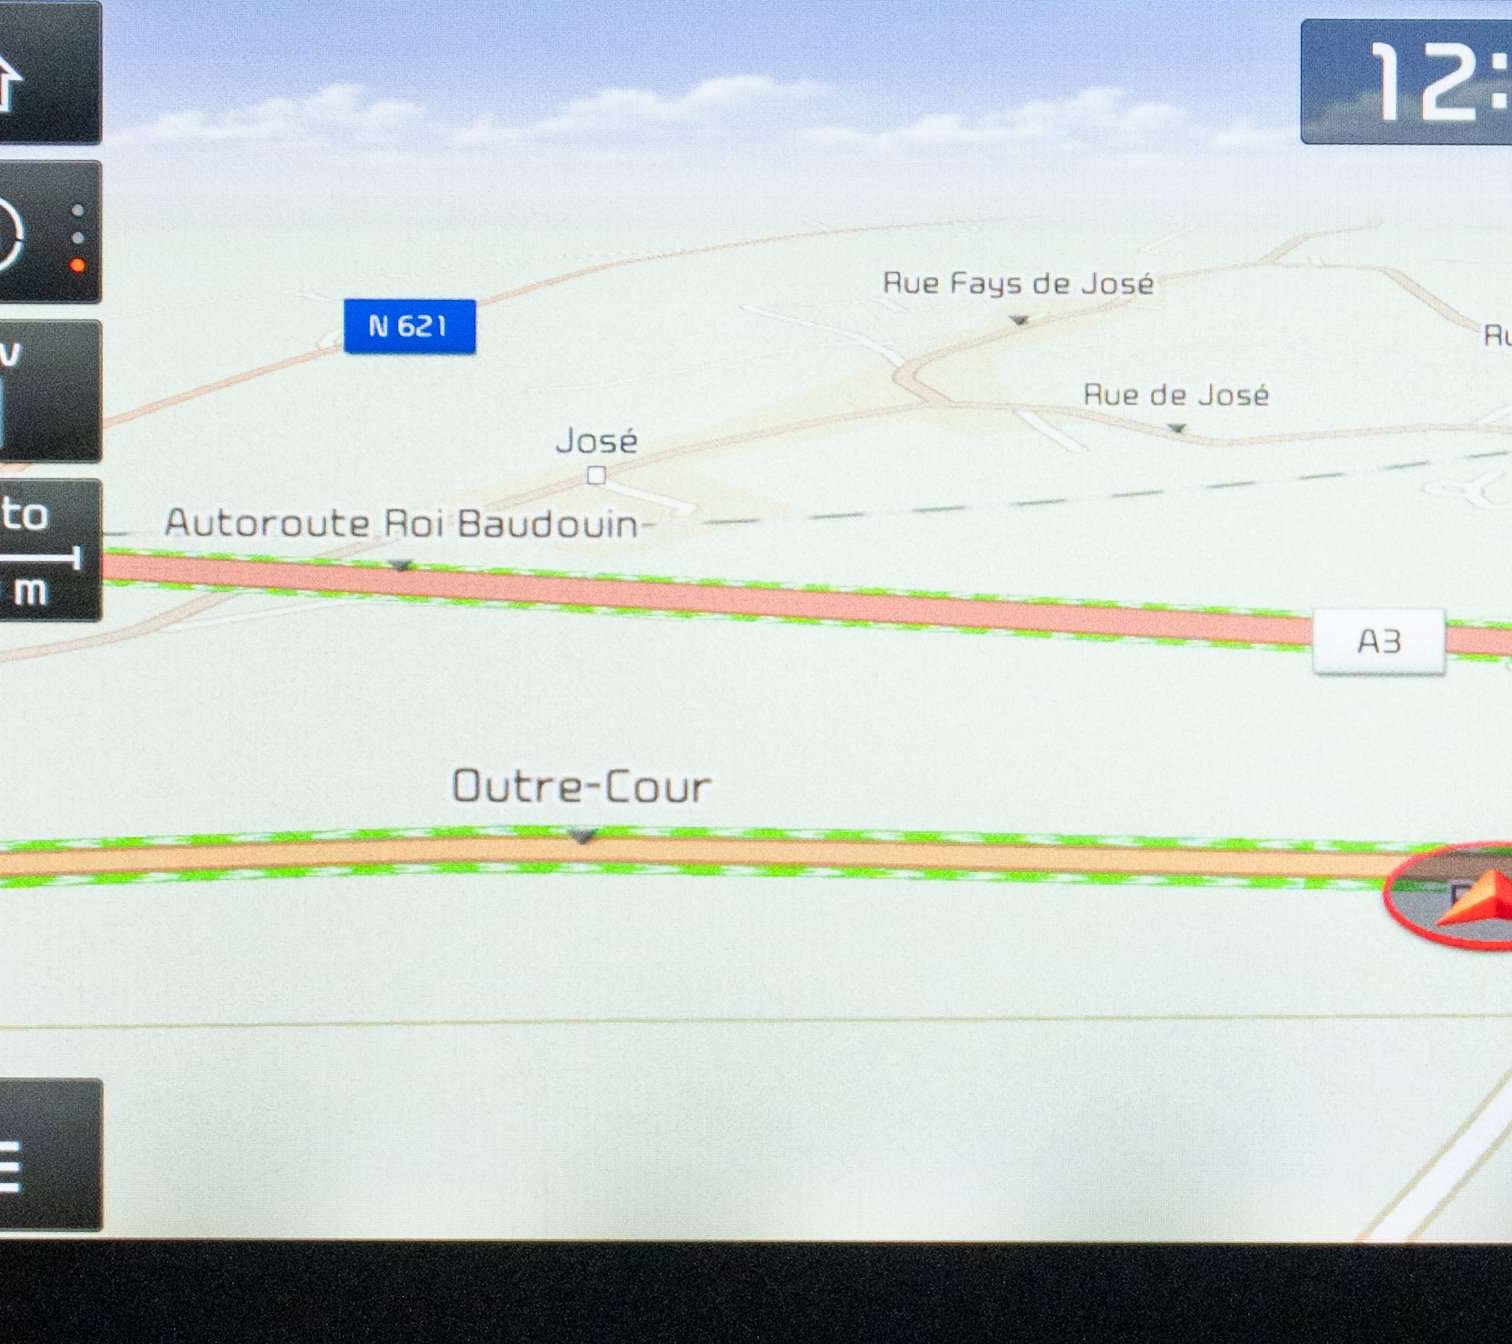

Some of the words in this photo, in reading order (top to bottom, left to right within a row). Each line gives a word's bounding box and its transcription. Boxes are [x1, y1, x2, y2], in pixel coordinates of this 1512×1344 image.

[883, 270, 940, 295] Rue
[950, 270, 1023, 300] Fays
[1033, 272, 1071, 295] de
[1081, 272, 1155, 296] José
[369, 314, 388, 338] N
[397, 314, 446, 338] 621
[1084, 382, 1139, 406] Rue
[1150, 383, 1185, 407] de
[1197, 383, 1270, 407] José
[555, 426, 638, 455] José
[164, 506, 370, 538] Autoroute
[385, 507, 443, 539] Roi
[458, 508, 638, 539] Baudouin
[14, 578, 47, 606] m
[1357, 628, 1402, 655] A3
[453, 767, 712, 804] Outre-Cour
